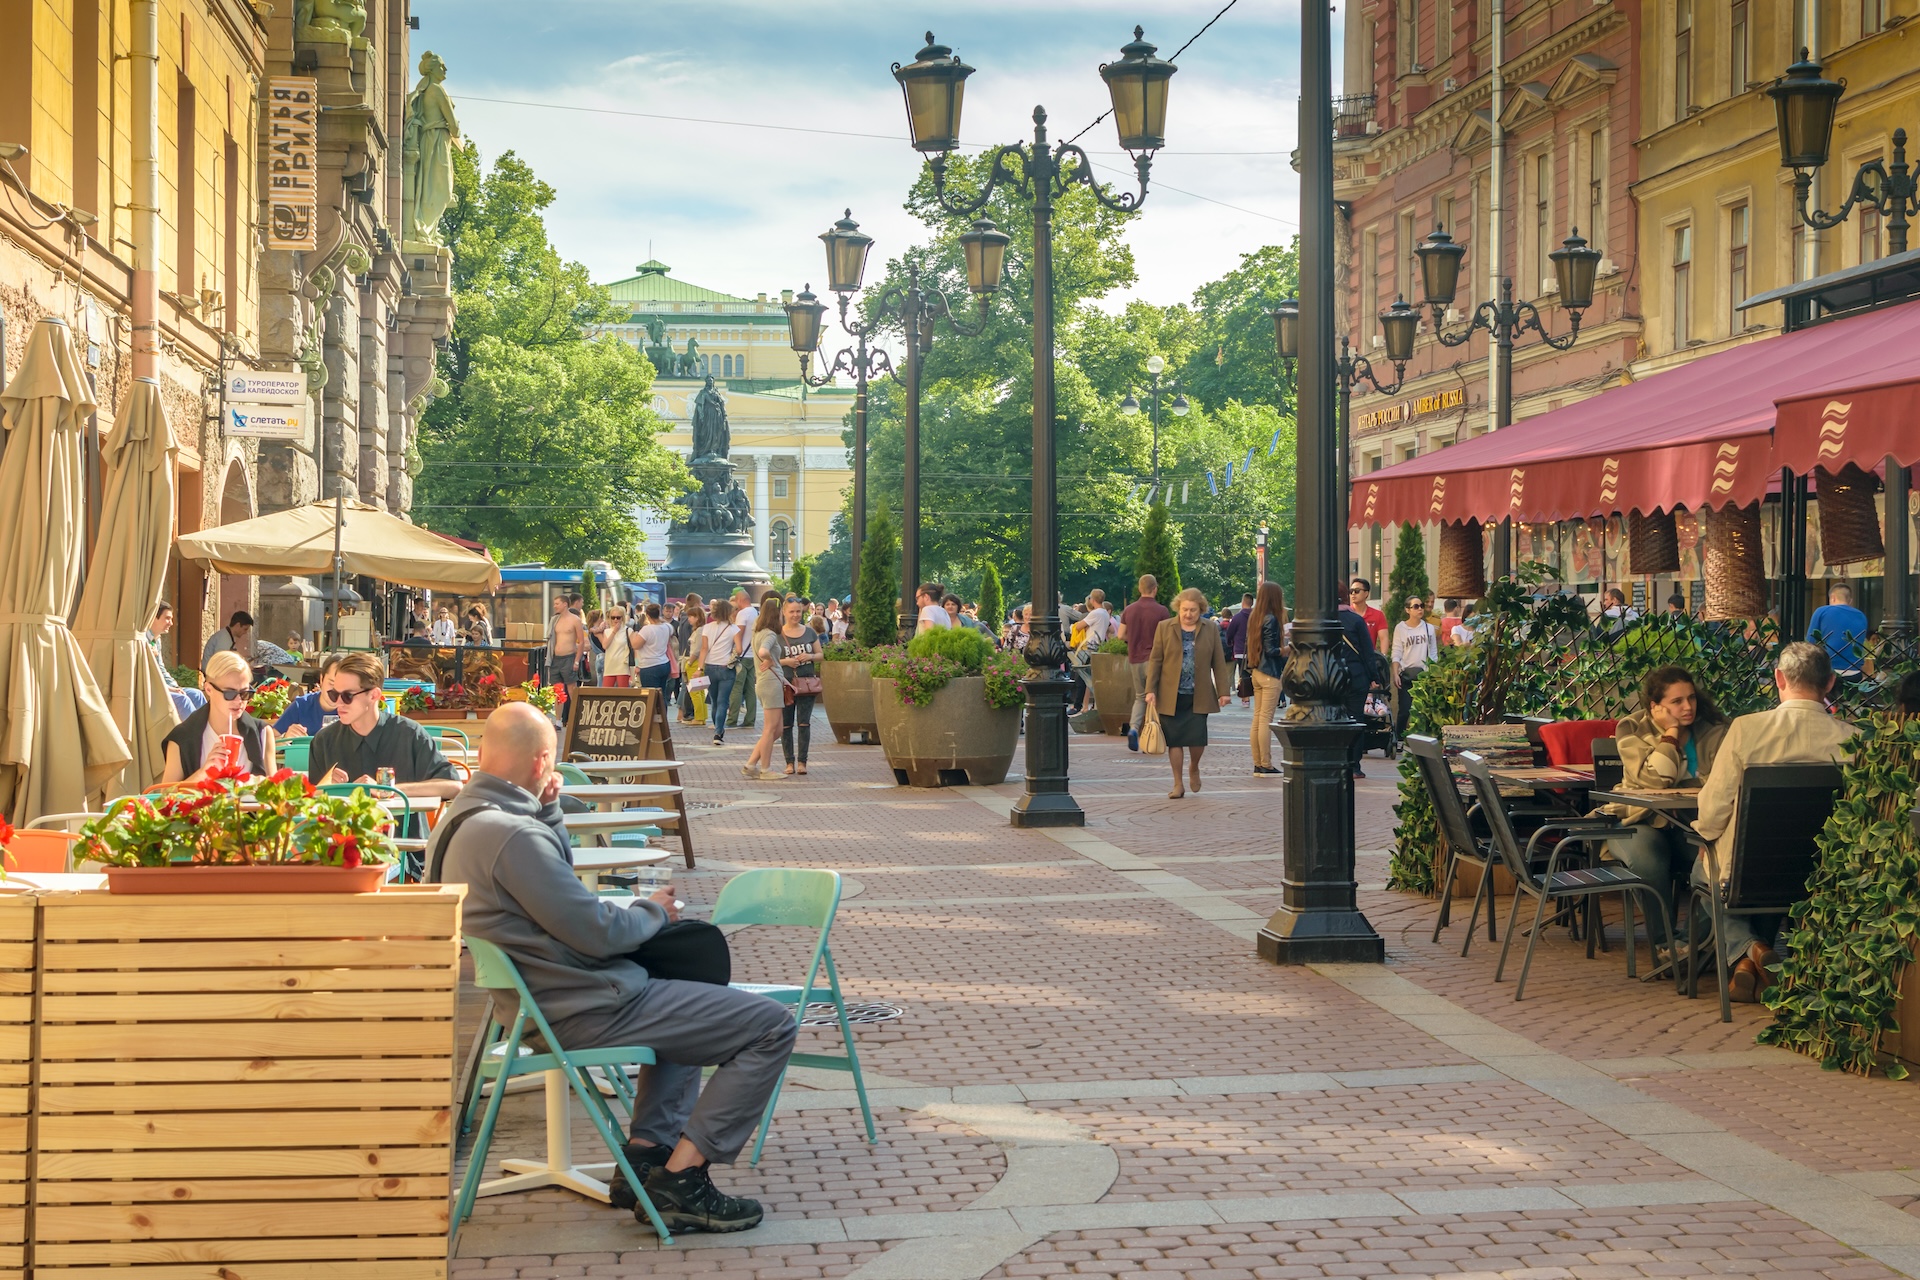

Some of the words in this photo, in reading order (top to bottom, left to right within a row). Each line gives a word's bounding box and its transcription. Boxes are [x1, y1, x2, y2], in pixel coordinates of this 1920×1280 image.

[273, 89, 291, 188] БРАТЬЯ
[292, 90, 310, 189] ГРИЛЬ
[247, 380, 300, 388] ТУРОПЕРАТОР
[247, 387, 299, 395] КАЛЕЙДОСКОП
[1412, 396, 1434, 416] AMBER
[1441, 388, 1463, 409] RUSSIA
[1378, 405, 1400, 426] РОССИИ
[784, 643, 813, 656] BOHO
[579, 700, 647, 728] МЯСО
